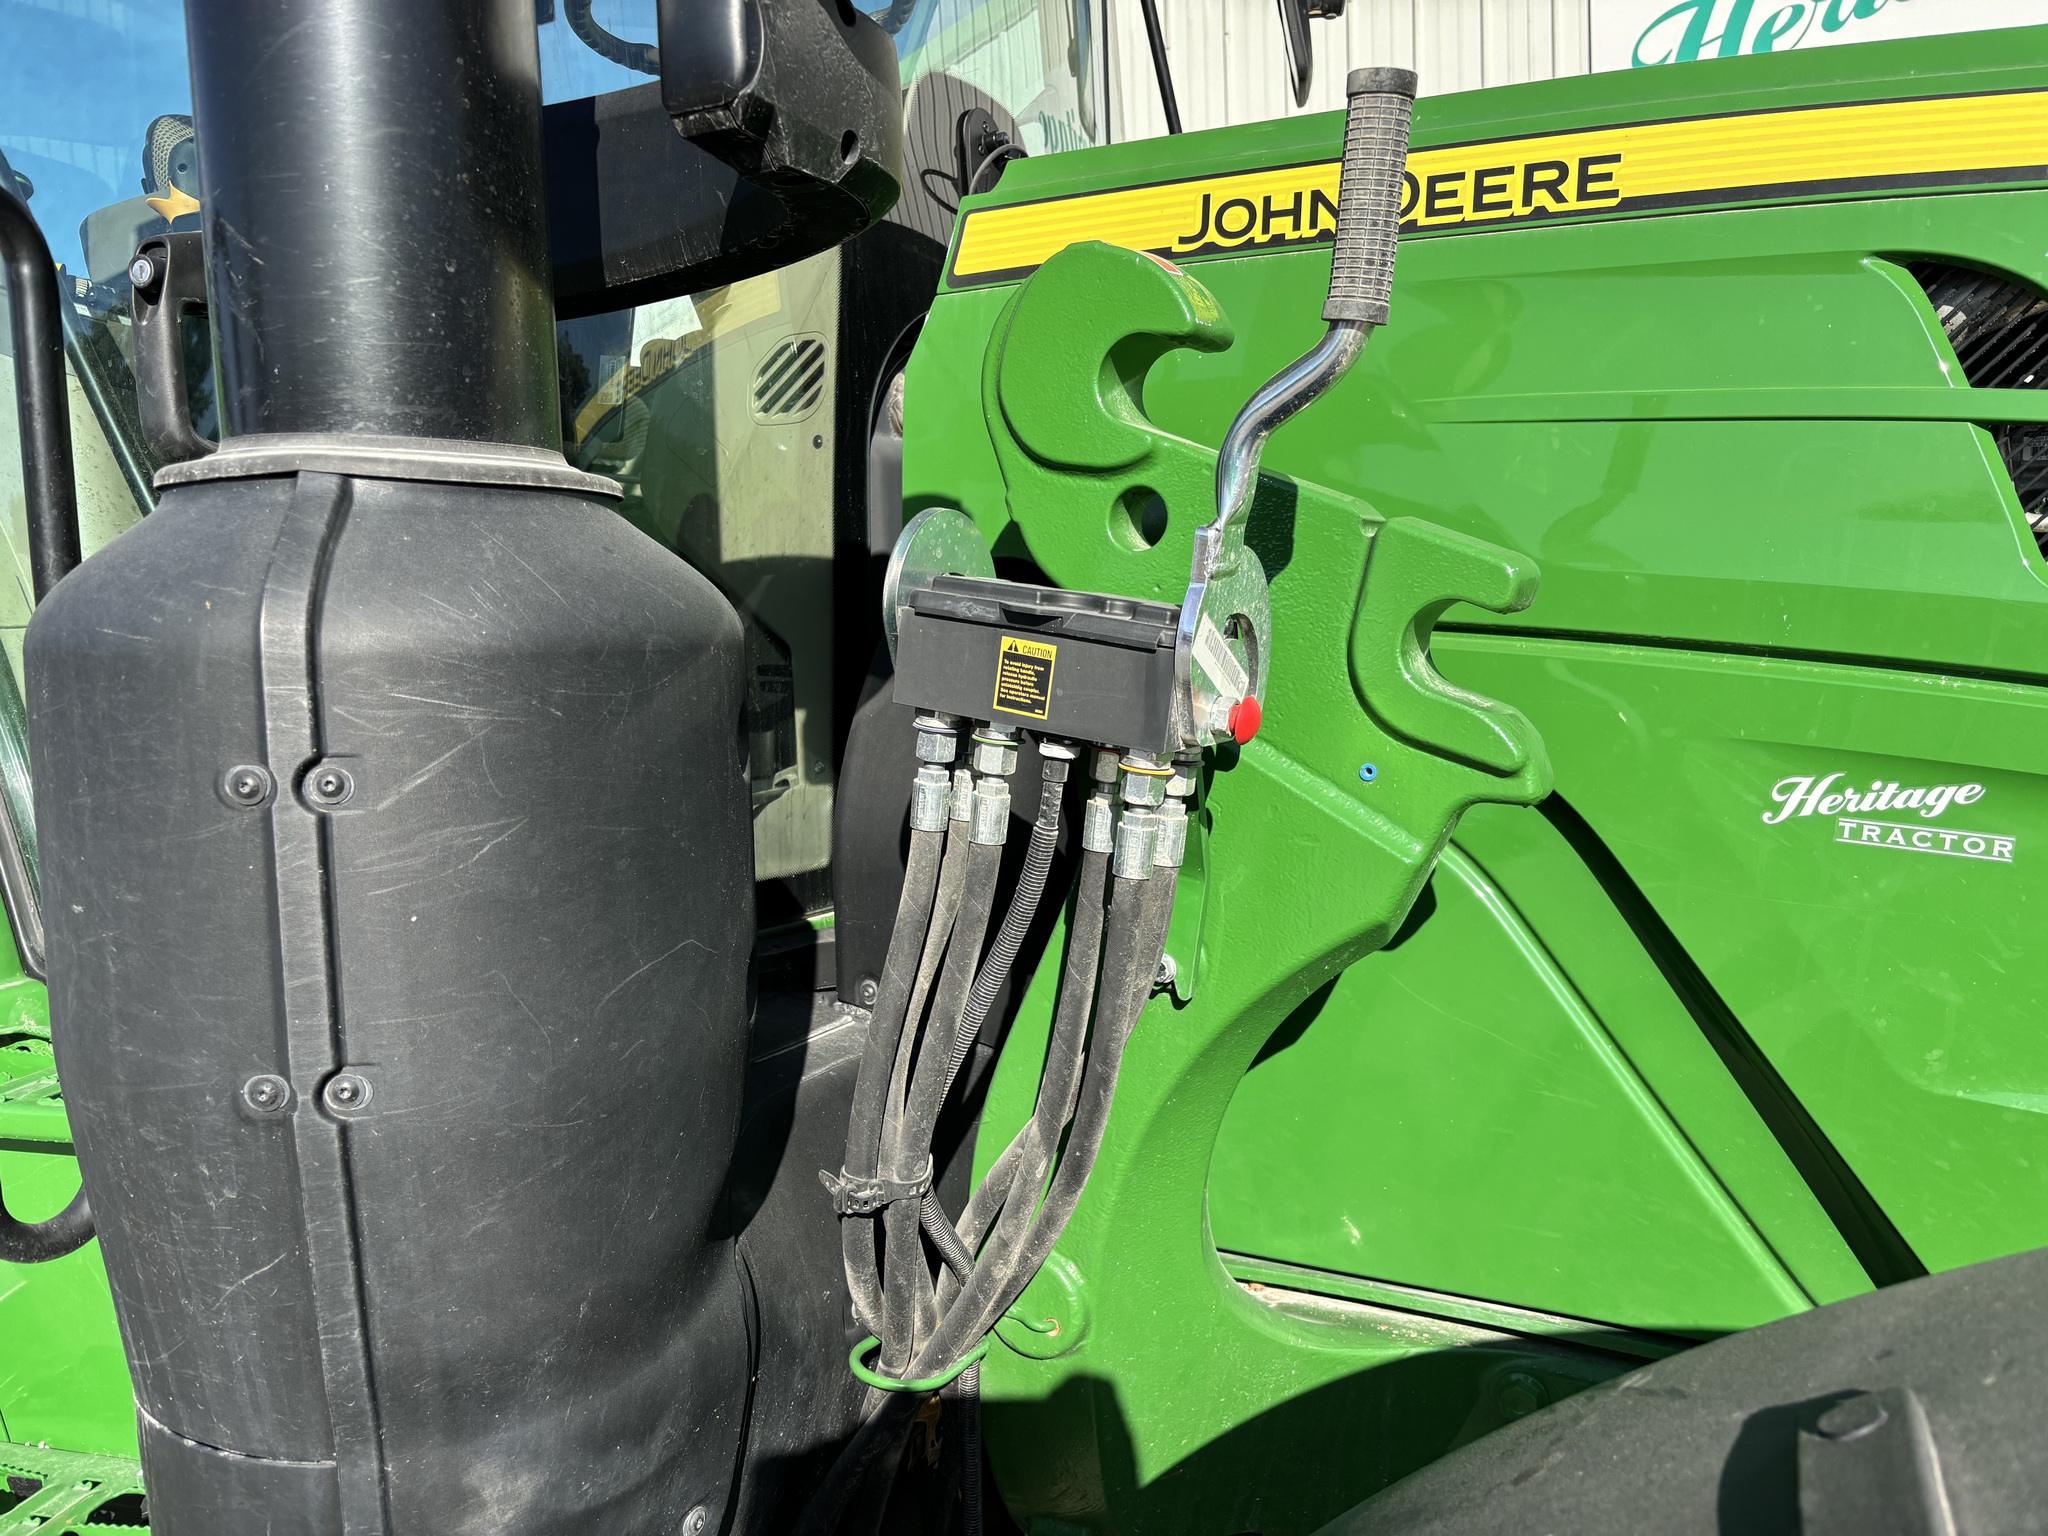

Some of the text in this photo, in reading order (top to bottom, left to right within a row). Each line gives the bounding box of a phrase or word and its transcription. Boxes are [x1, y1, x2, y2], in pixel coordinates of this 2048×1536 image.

[1178, 189, 1339, 246] JOHN
[1022, 645, 1053, 659] CAUTION
[1018, 673, 1037, 682] hydraulic
[1022, 662, 1034, 670] injury
[1762, 772, 1986, 825] Heritage
[1838, 821, 2013, 858] TRACTOR
